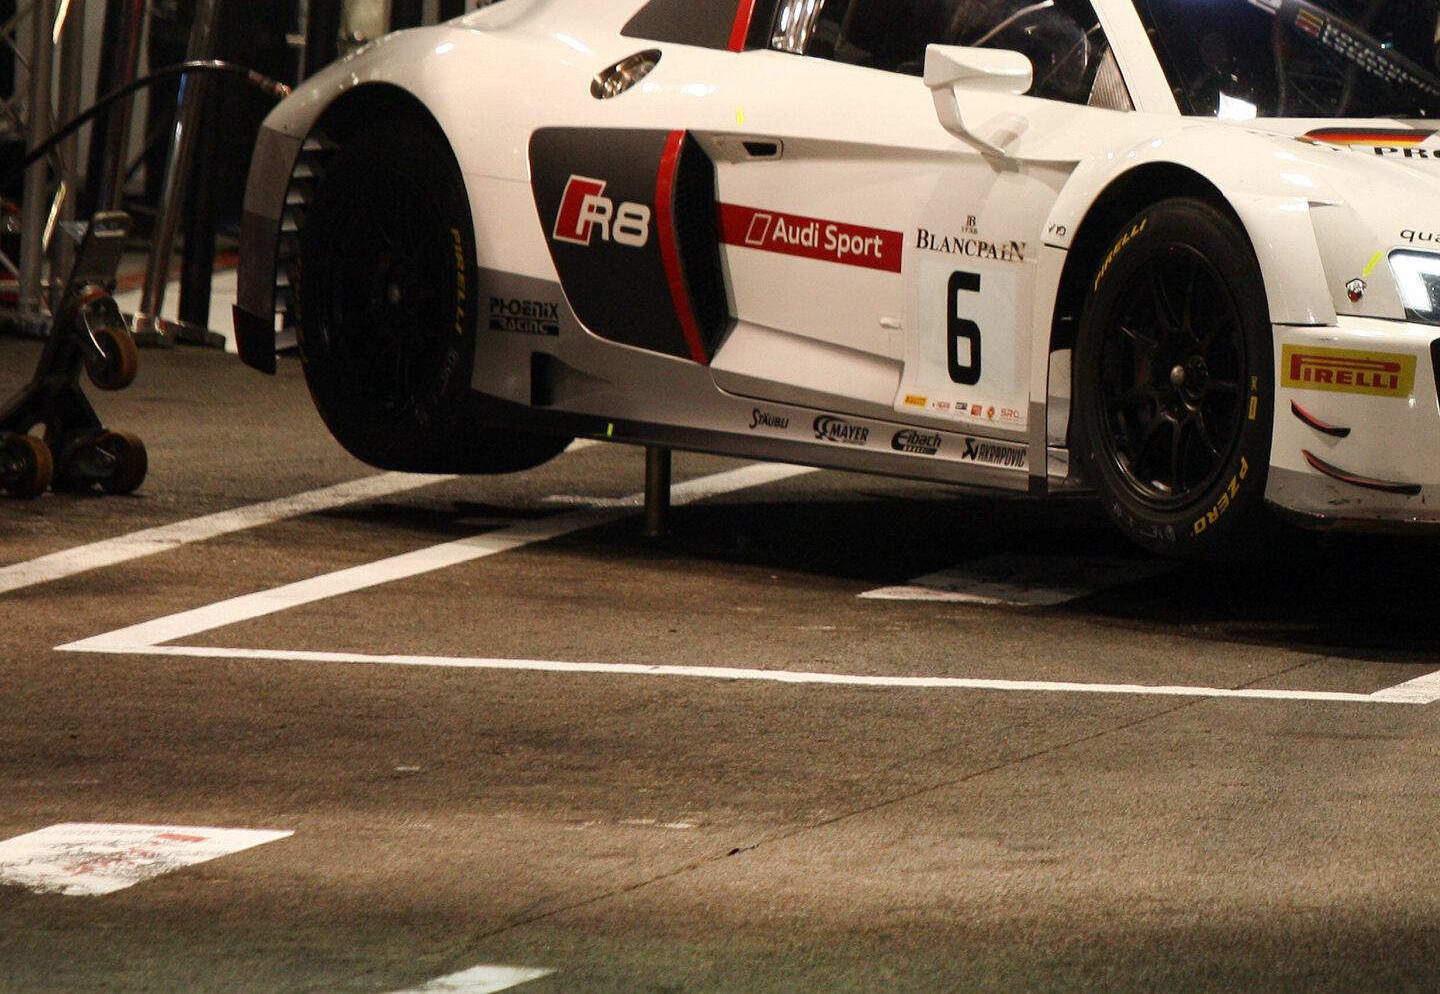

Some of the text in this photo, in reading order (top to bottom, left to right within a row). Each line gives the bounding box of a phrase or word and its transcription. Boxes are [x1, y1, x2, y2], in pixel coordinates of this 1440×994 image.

[576, 192, 651, 248] R8
[773, 217, 883, 258] Audi Sport
[916, 228, 1026, 261] BLANCPAIN
[1094, 218, 1147, 292] PIRELLI
[947, 271, 982, 386] 6
[1290, 354, 1401, 390] PIRELLI
[829, 424, 869, 442] MAYER
[891, 428, 942, 452] Eibach
